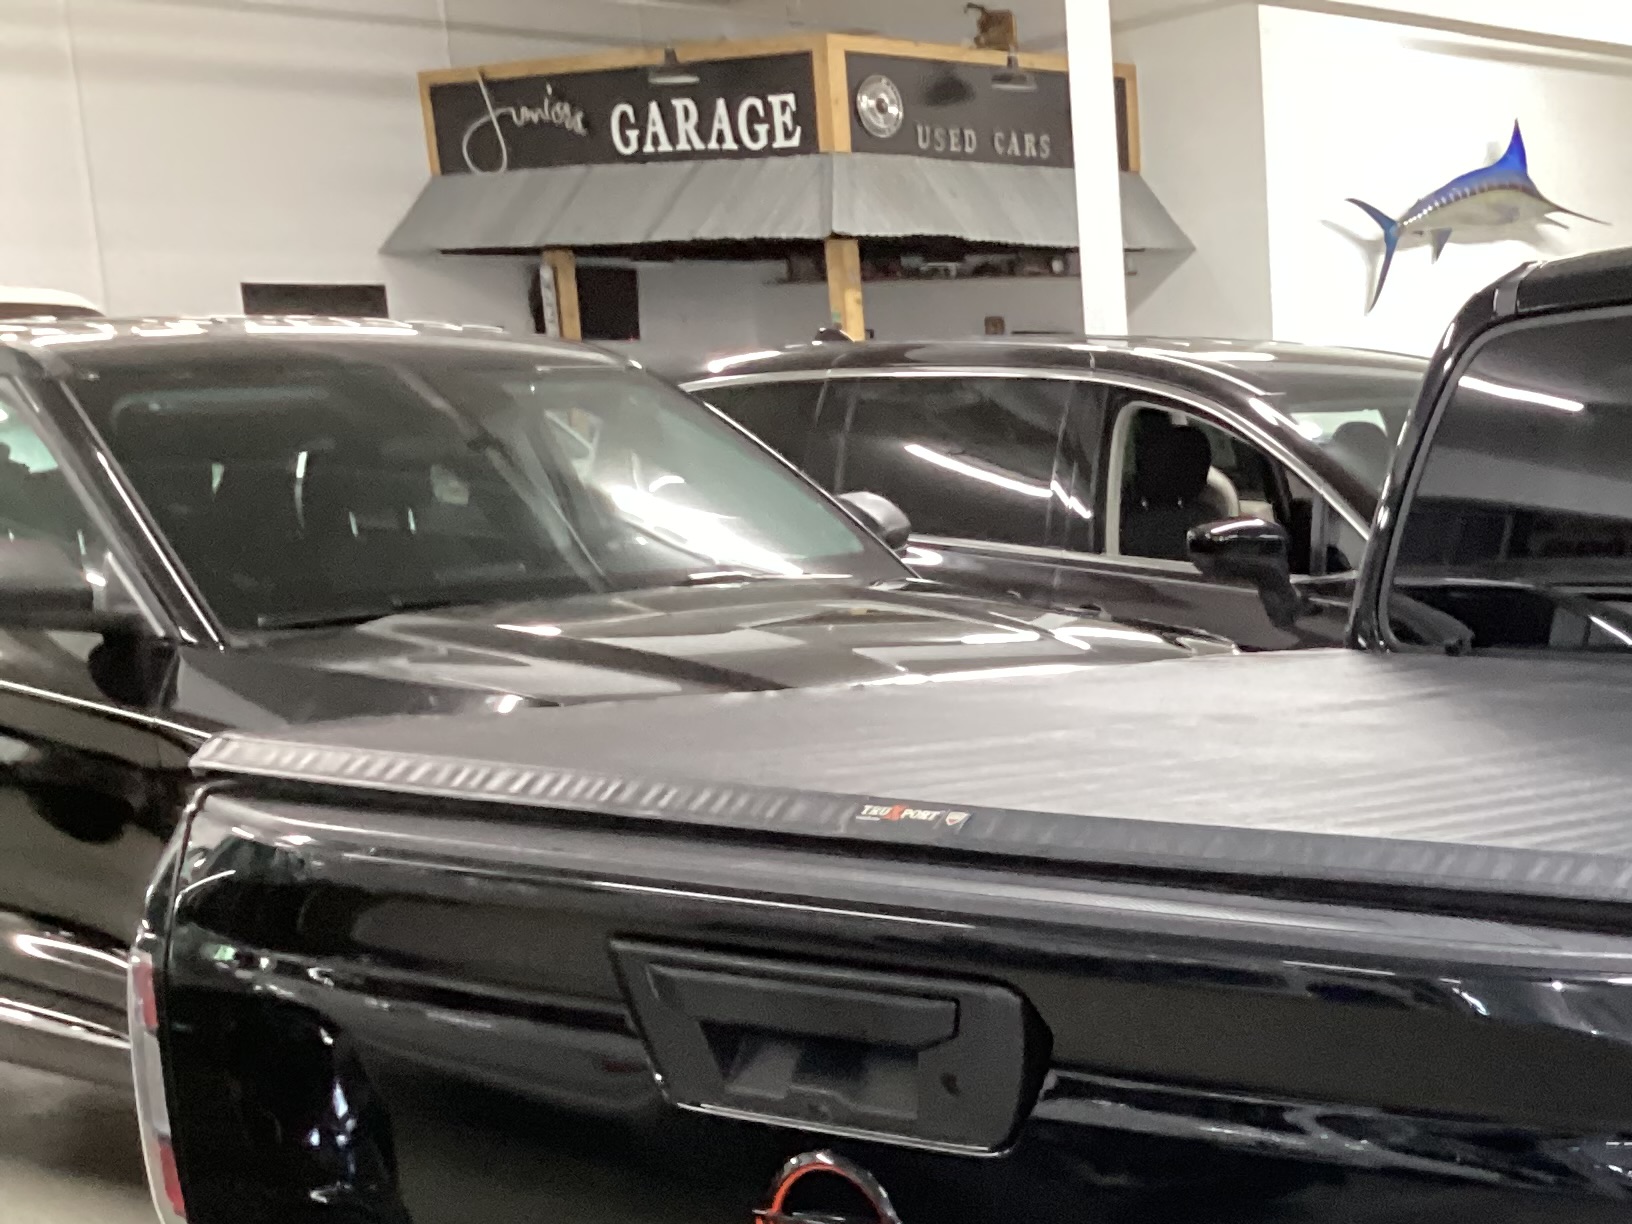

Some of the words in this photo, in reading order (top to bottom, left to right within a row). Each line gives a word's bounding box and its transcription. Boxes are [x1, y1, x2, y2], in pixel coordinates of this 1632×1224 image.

[610, 93, 801, 155] GARAGE
[916, 124, 977, 154] USED
[993, 130, 1051, 160] CARS
